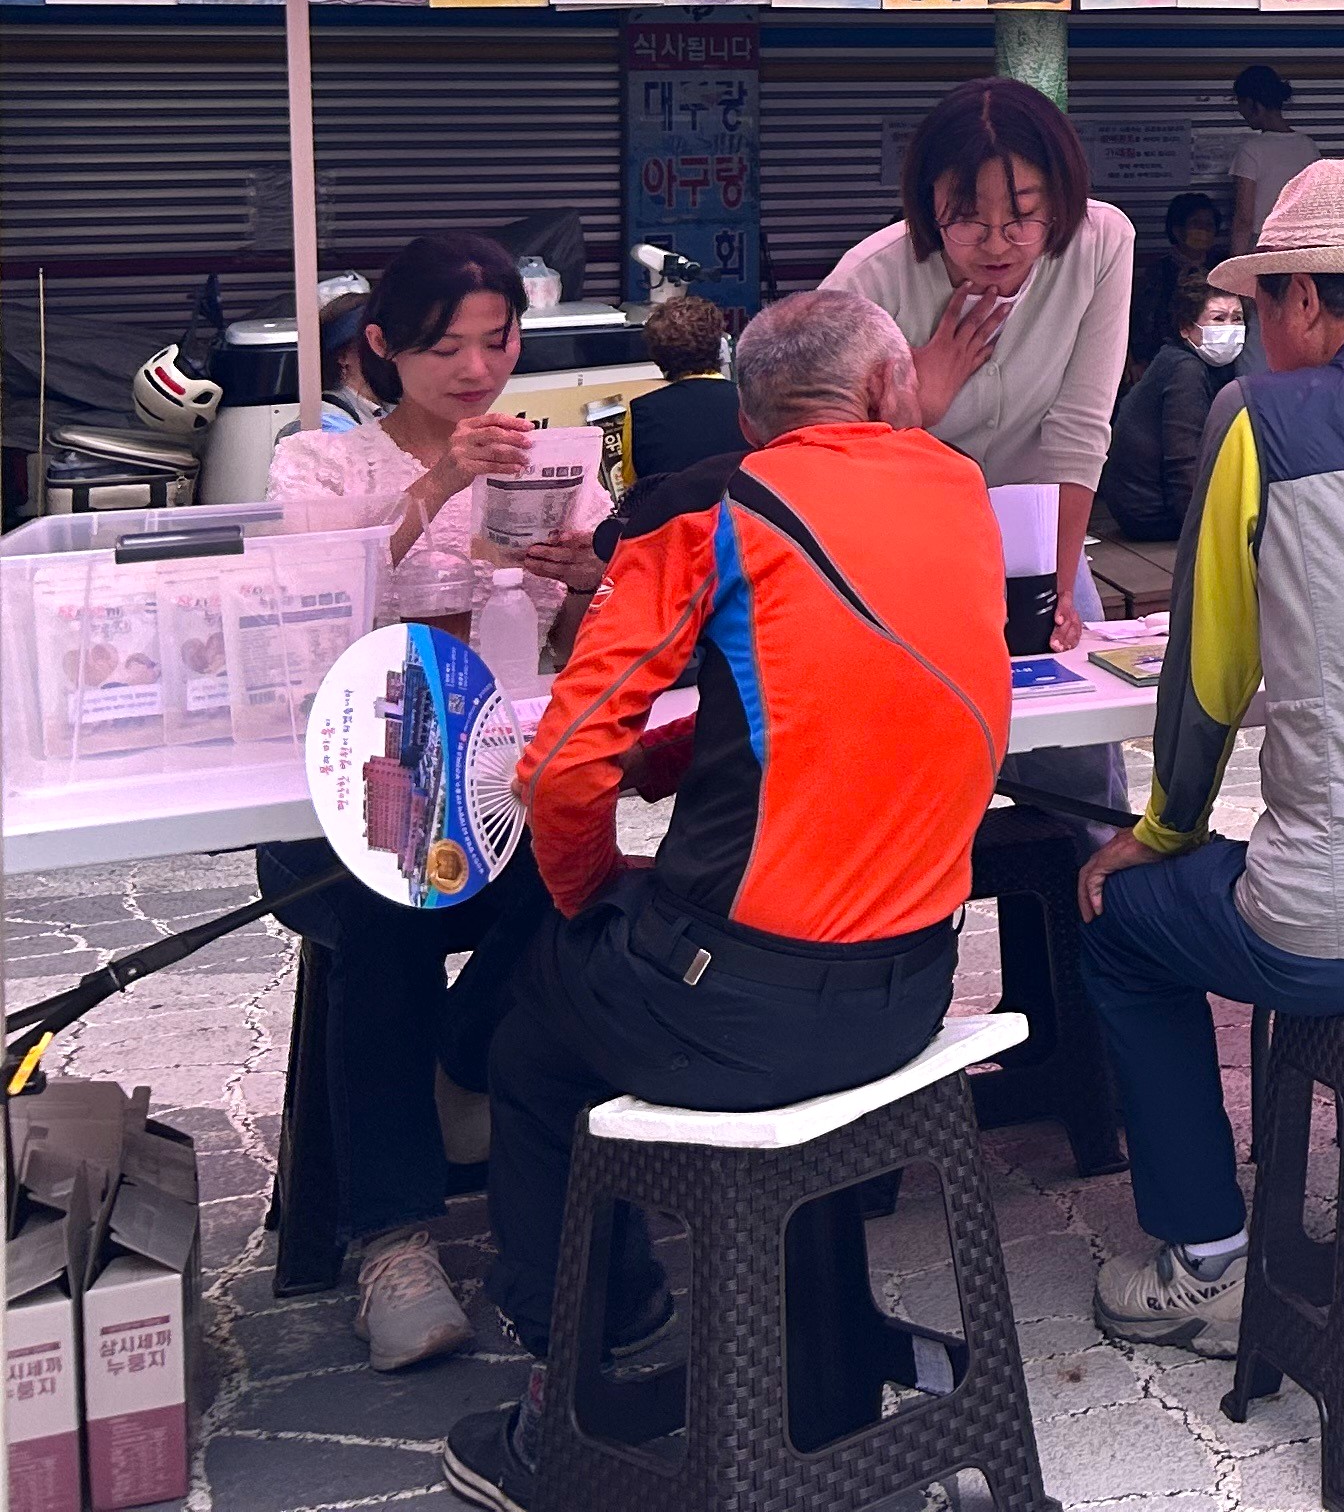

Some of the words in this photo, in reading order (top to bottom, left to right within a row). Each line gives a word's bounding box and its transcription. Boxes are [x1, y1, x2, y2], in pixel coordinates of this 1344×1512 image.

[634, 33, 752, 62] 식사됩니다
[100, 1329, 172, 1358] 삼시세끼
[107, 1349, 166, 1376] 누룽지
